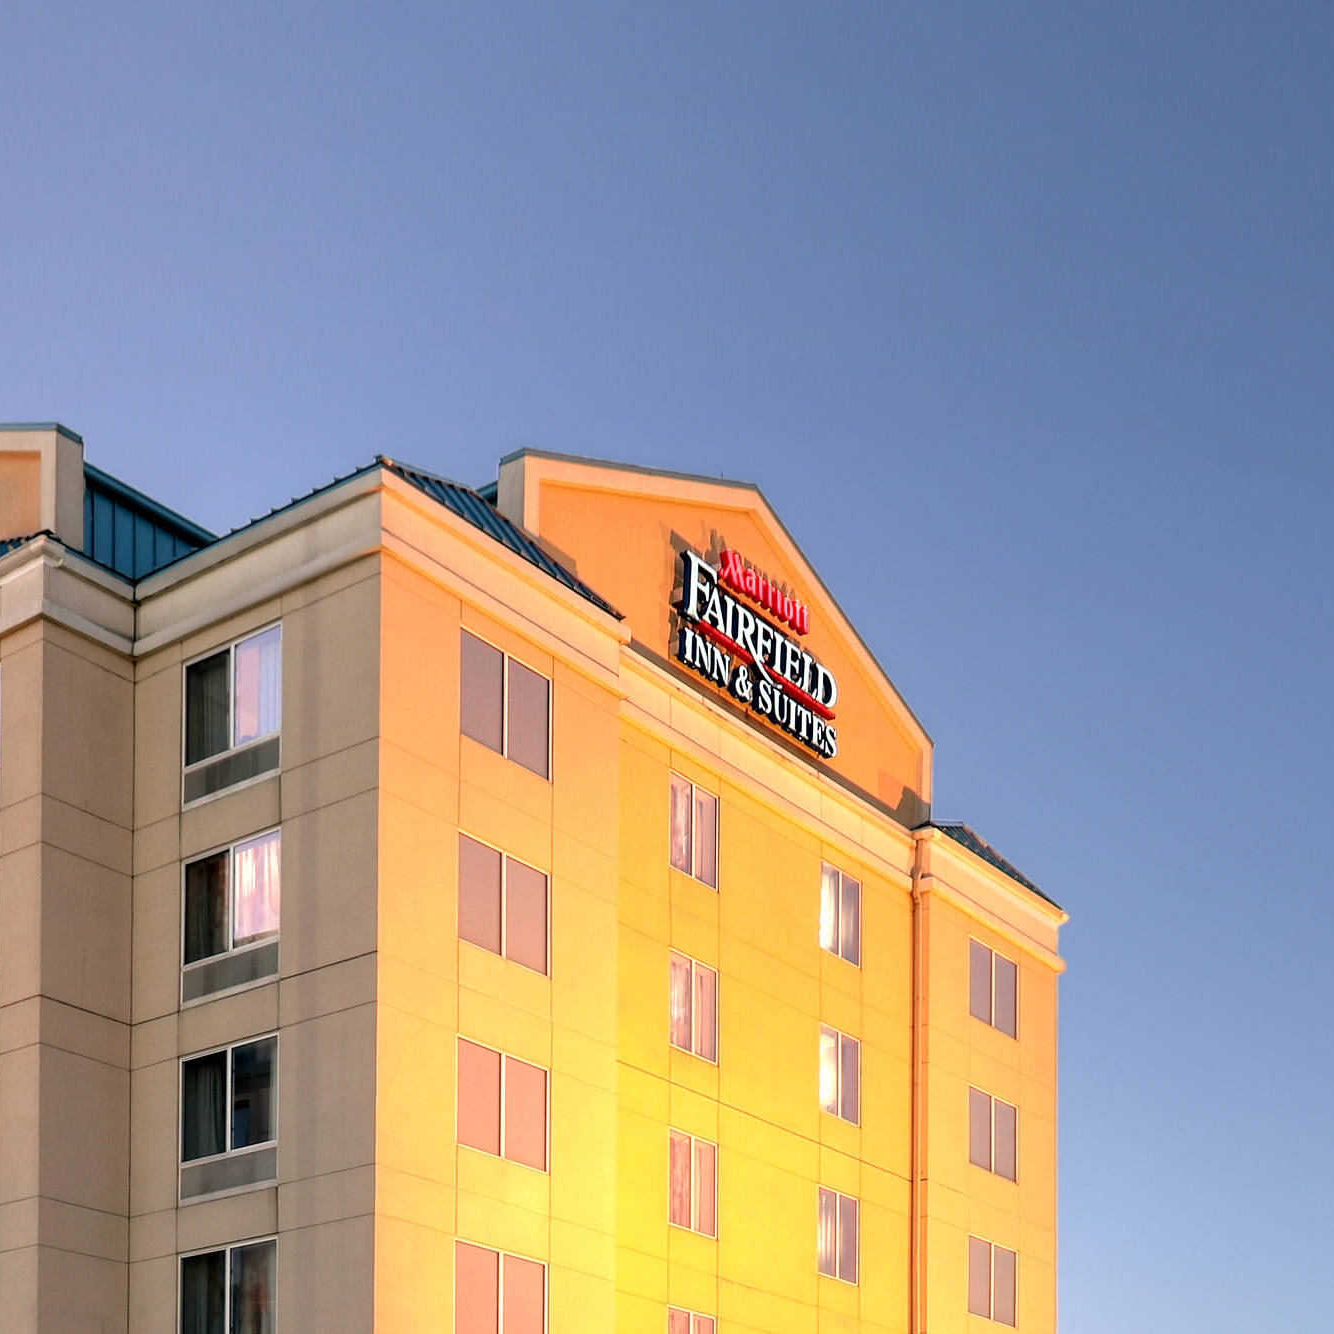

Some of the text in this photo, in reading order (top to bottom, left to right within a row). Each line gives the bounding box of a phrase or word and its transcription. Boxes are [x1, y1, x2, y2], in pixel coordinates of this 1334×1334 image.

[681, 549, 838, 709] FAIRFIELD
[718, 548, 809, 635] Marriott
[681, 626, 838, 758] INN & SUITES
